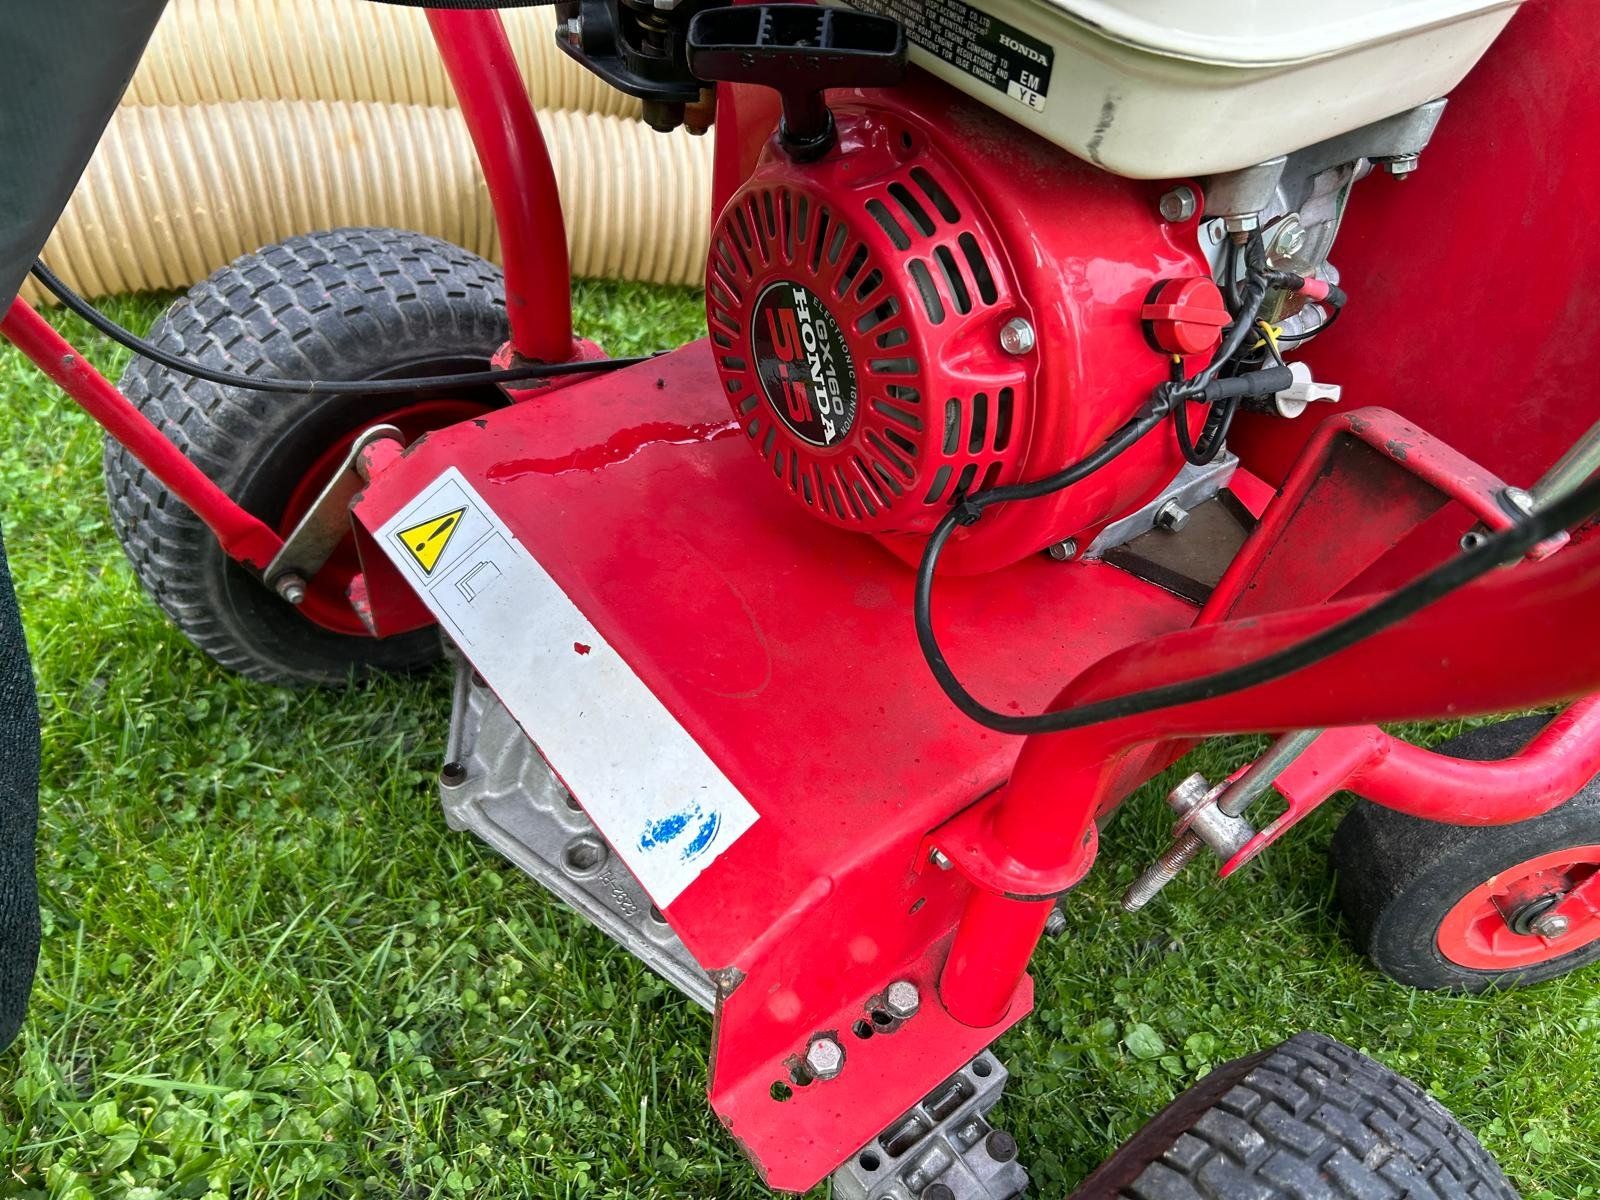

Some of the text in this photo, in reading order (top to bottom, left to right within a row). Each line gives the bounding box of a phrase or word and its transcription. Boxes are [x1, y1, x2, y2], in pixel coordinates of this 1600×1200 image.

[905, 28, 940, 54] REGULATIONS
[939, 15, 977, 42] MAINTENANCE
[944, 28, 964, 46] ENGINE
[966, 41, 998, 63] CONFORMS
[1000, 58, 1009, 69] TO
[999, 34, 1048, 67] HONDA
[934, 33, 954, 51] ENGINE
[956, 46, 993, 72] REGULATIONS
[996, 67, 1009, 80] AND
[1020, 70, 1040, 91] EM
[813, 296, 856, 379] ELECTRONIC
[765, 308, 813, 422] 5.5
[793, 287, 837, 445] HONDA
[815, 319, 844, 417] GX160
[840, 385, 858, 436] IGNITION
